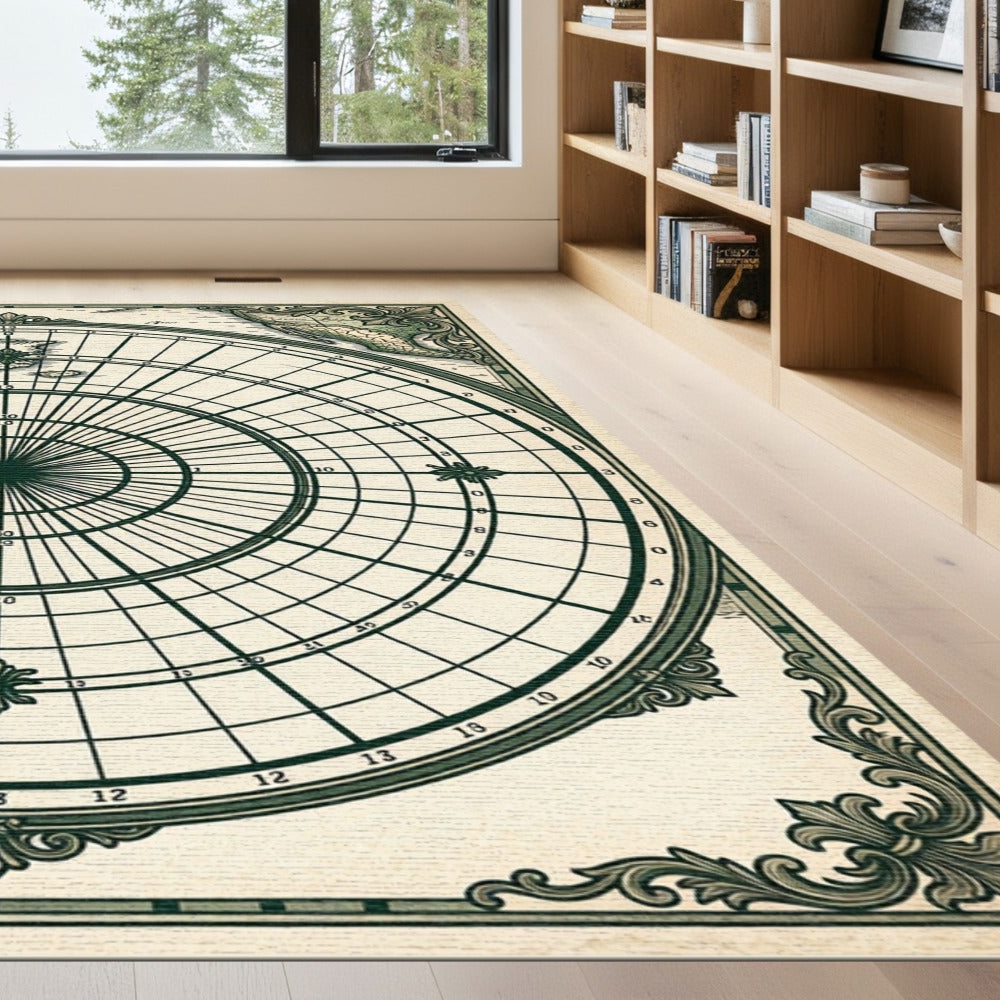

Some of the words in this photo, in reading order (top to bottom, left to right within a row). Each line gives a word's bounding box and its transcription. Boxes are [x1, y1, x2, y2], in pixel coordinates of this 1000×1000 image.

[528, 691, 558, 706] 10
[361, 749, 397, 765] 13
[254, 770, 290, 786] 12
[92, 788, 128, 802] 12
